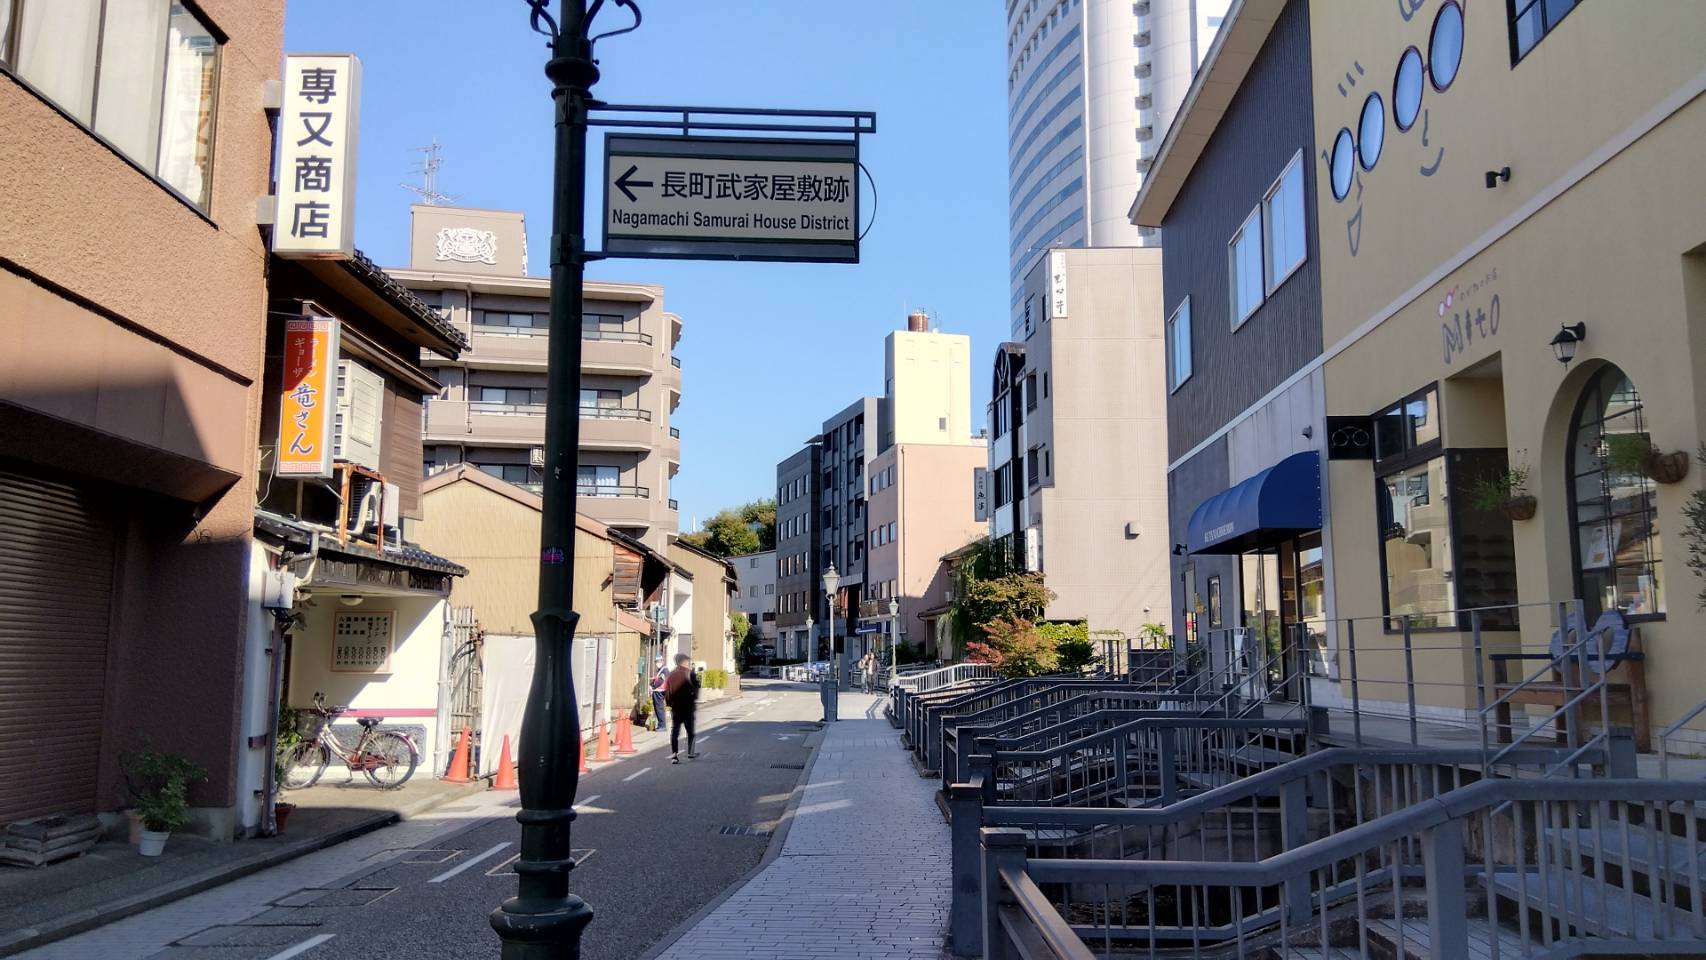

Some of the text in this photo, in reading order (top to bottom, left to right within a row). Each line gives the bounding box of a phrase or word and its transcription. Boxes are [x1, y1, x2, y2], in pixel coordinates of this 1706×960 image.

[290, 67, 337, 239] 専又商店
[661, 171, 850, 204] 長町武家屋敷跡
[612, 208, 850, 231] Nagamachi Samurai House District
[292, 336, 306, 379] ギョーザ
[307, 337, 321, 378] ラーメン
[289, 383, 317, 455] 竜さん
